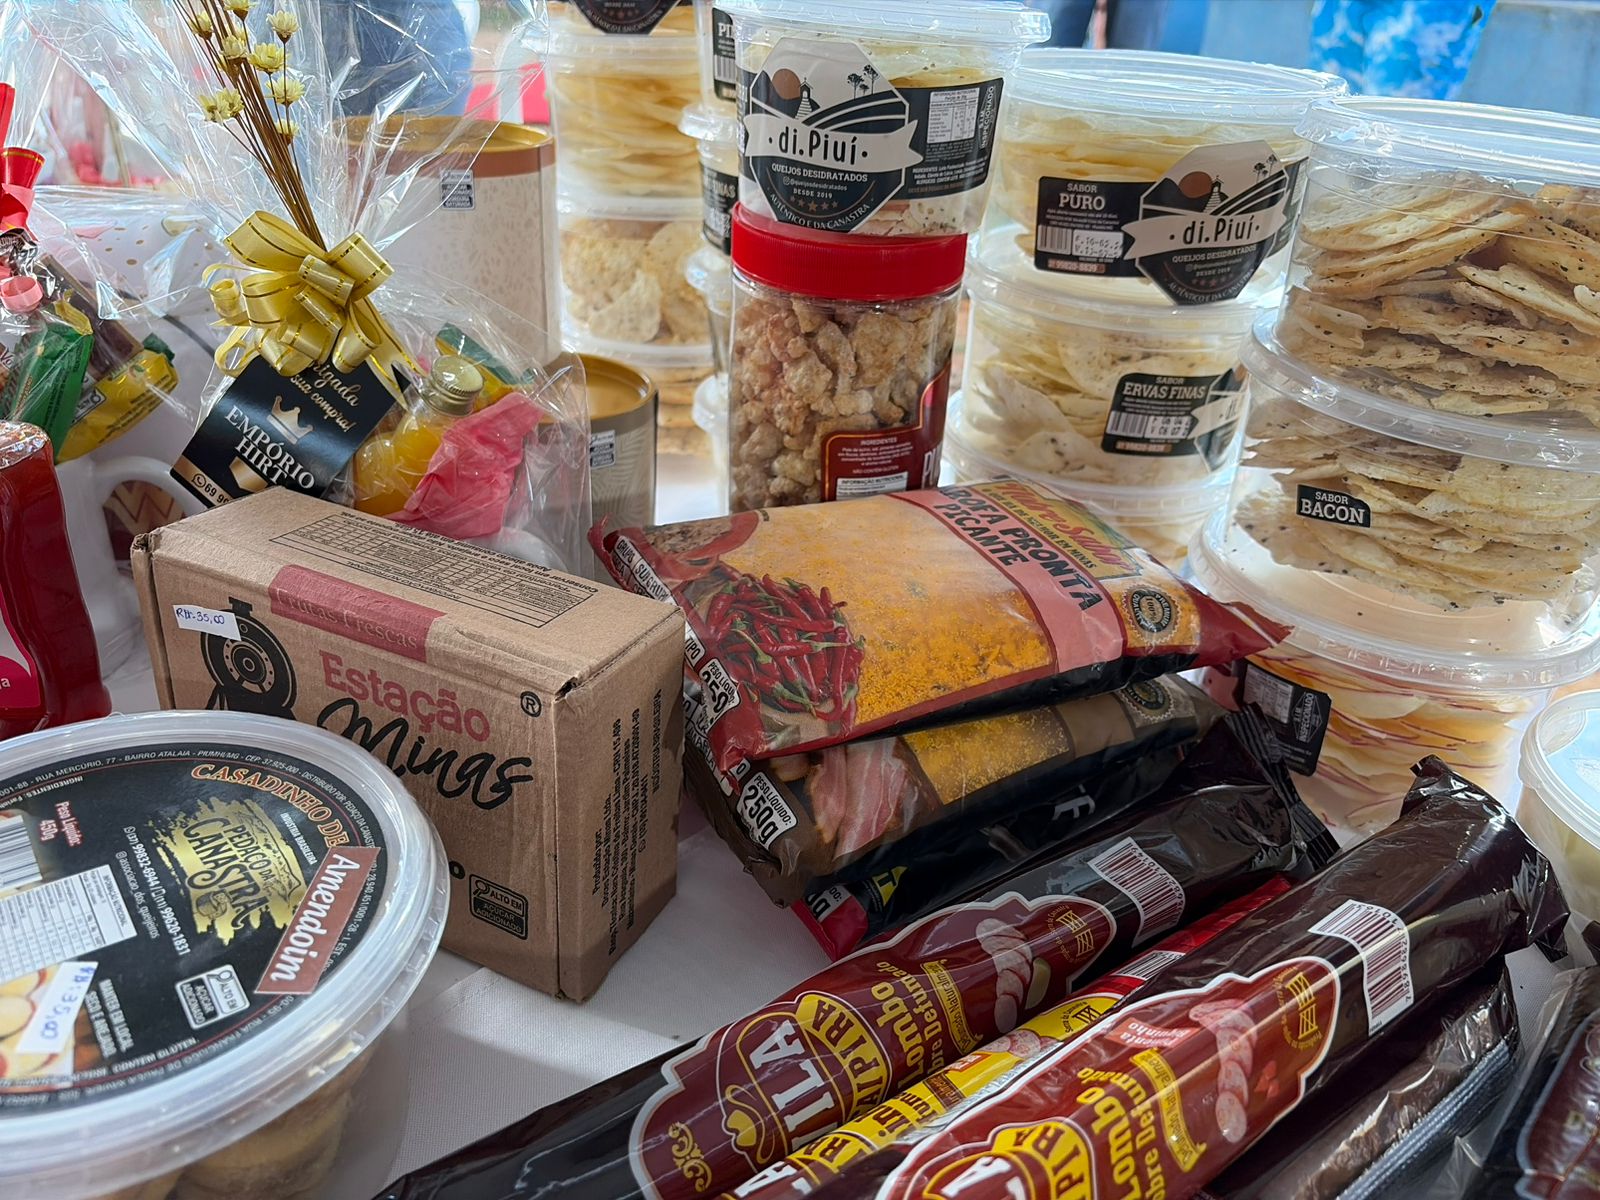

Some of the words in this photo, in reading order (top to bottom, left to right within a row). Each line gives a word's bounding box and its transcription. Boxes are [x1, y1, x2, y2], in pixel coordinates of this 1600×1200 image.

[772, 162, 801, 177] QUEIJOS
[803, 169, 868, 182] DESIDRATADOS
[1067, 183, 1097, 193] SABOR
[793, 188, 815, 198] DESDE
[816, 191, 833, 199] 2019
[1058, 193, 1106, 211] PURO
[770, 194, 806, 227] AUTÊNTICO
[814, 221, 826, 229] DA
[826, 203, 871, 229] CANASTRA
[1172, 254, 1206, 263] QUEIJOS
[1207, 245, 1257, 260] DESIDRATADOS
[1122, 382, 1169, 399] ERVAS
[1169, 386, 1208, 400] FINAS
[1156, 377, 1184, 385] SABOR
[290, 374, 311, 395] sua
[311, 392, 356, 432] compra!
[225, 405, 315, 489] EMPÓRIO
[235, 438, 288, 485] HIRT
[204, 484, 216, 497] 69
[1315, 491, 1349, 505] SABOR
[1300, 498, 1365, 525] BACON
[616, 539, 635, 563] GRUPO
[934, 504, 1031, 566] PICANTE
[938, 484, 1009, 525] ROFA
[1000, 527, 1103, 611] PRONTA
[1056, 539, 1073, 550] EM
[1070, 549, 1098, 570] MINAS
[548, 574, 600, 594] Conservar
[1154, 593, 1172, 628] PREMIUM
[685, 638, 701, 660] TIPO
[708, 661, 722, 680] PESO
[319, 650, 491, 742] Estação
[702, 670, 732, 716] 250
[1299, 692, 1315, 743] INSPECIONADO
[317, 697, 534, 811] Minas
[24, 776, 84, 798] INGREDIENTES:
[35, 773, 55, 782] RUA
[56, 760, 104, 776] MERCÚRIO,
[106, 757, 117, 765] 77
[124, 752, 156, 762] BAIRRO
[158, 750, 190, 758] ATALAIA
[197, 750, 239, 760] PIUMHI/MG
[302, 771, 337, 795] DISTRIBUÍDO
[343, 800, 361, 820] PEDAÇO
[755, 775, 769, 793] PESO
[765, 791, 792, 826] LÍQUIDO:
[55, 800, 71, 820] Peso
[191, 763, 332, 822] CASADINHO
[318, 818, 350, 848] DE
[744, 784, 779, 844] 250g
[39, 819, 57, 841] 450g
[61, 819, 82, 847] Líquido:
[222, 823, 272, 871] PEDAÇO
[294, 834, 318, 865] BRASILEIRA
[1130, 846, 1166, 878] 710149
[183, 816, 270, 931] CANASTRA
[132, 844, 160, 891] 99832-6944
[160, 906, 191, 956] 99620-1831
[490, 891, 510, 905] ALTO
[270, 853, 361, 982] Amendoin
[476, 908, 522, 933] ADICIONADO
[99, 978, 121, 1010] MANTER
[114, 1022, 135, 1053] LOCAL
[876, 961, 942, 1041] Defumado
[872, 981, 924, 1088] Lombo
[1078, 1067, 1156, 1149] Defumado
[1077, 1087, 1142, 1200] Lombo
[1145, 1148, 1167, 1200] obre
